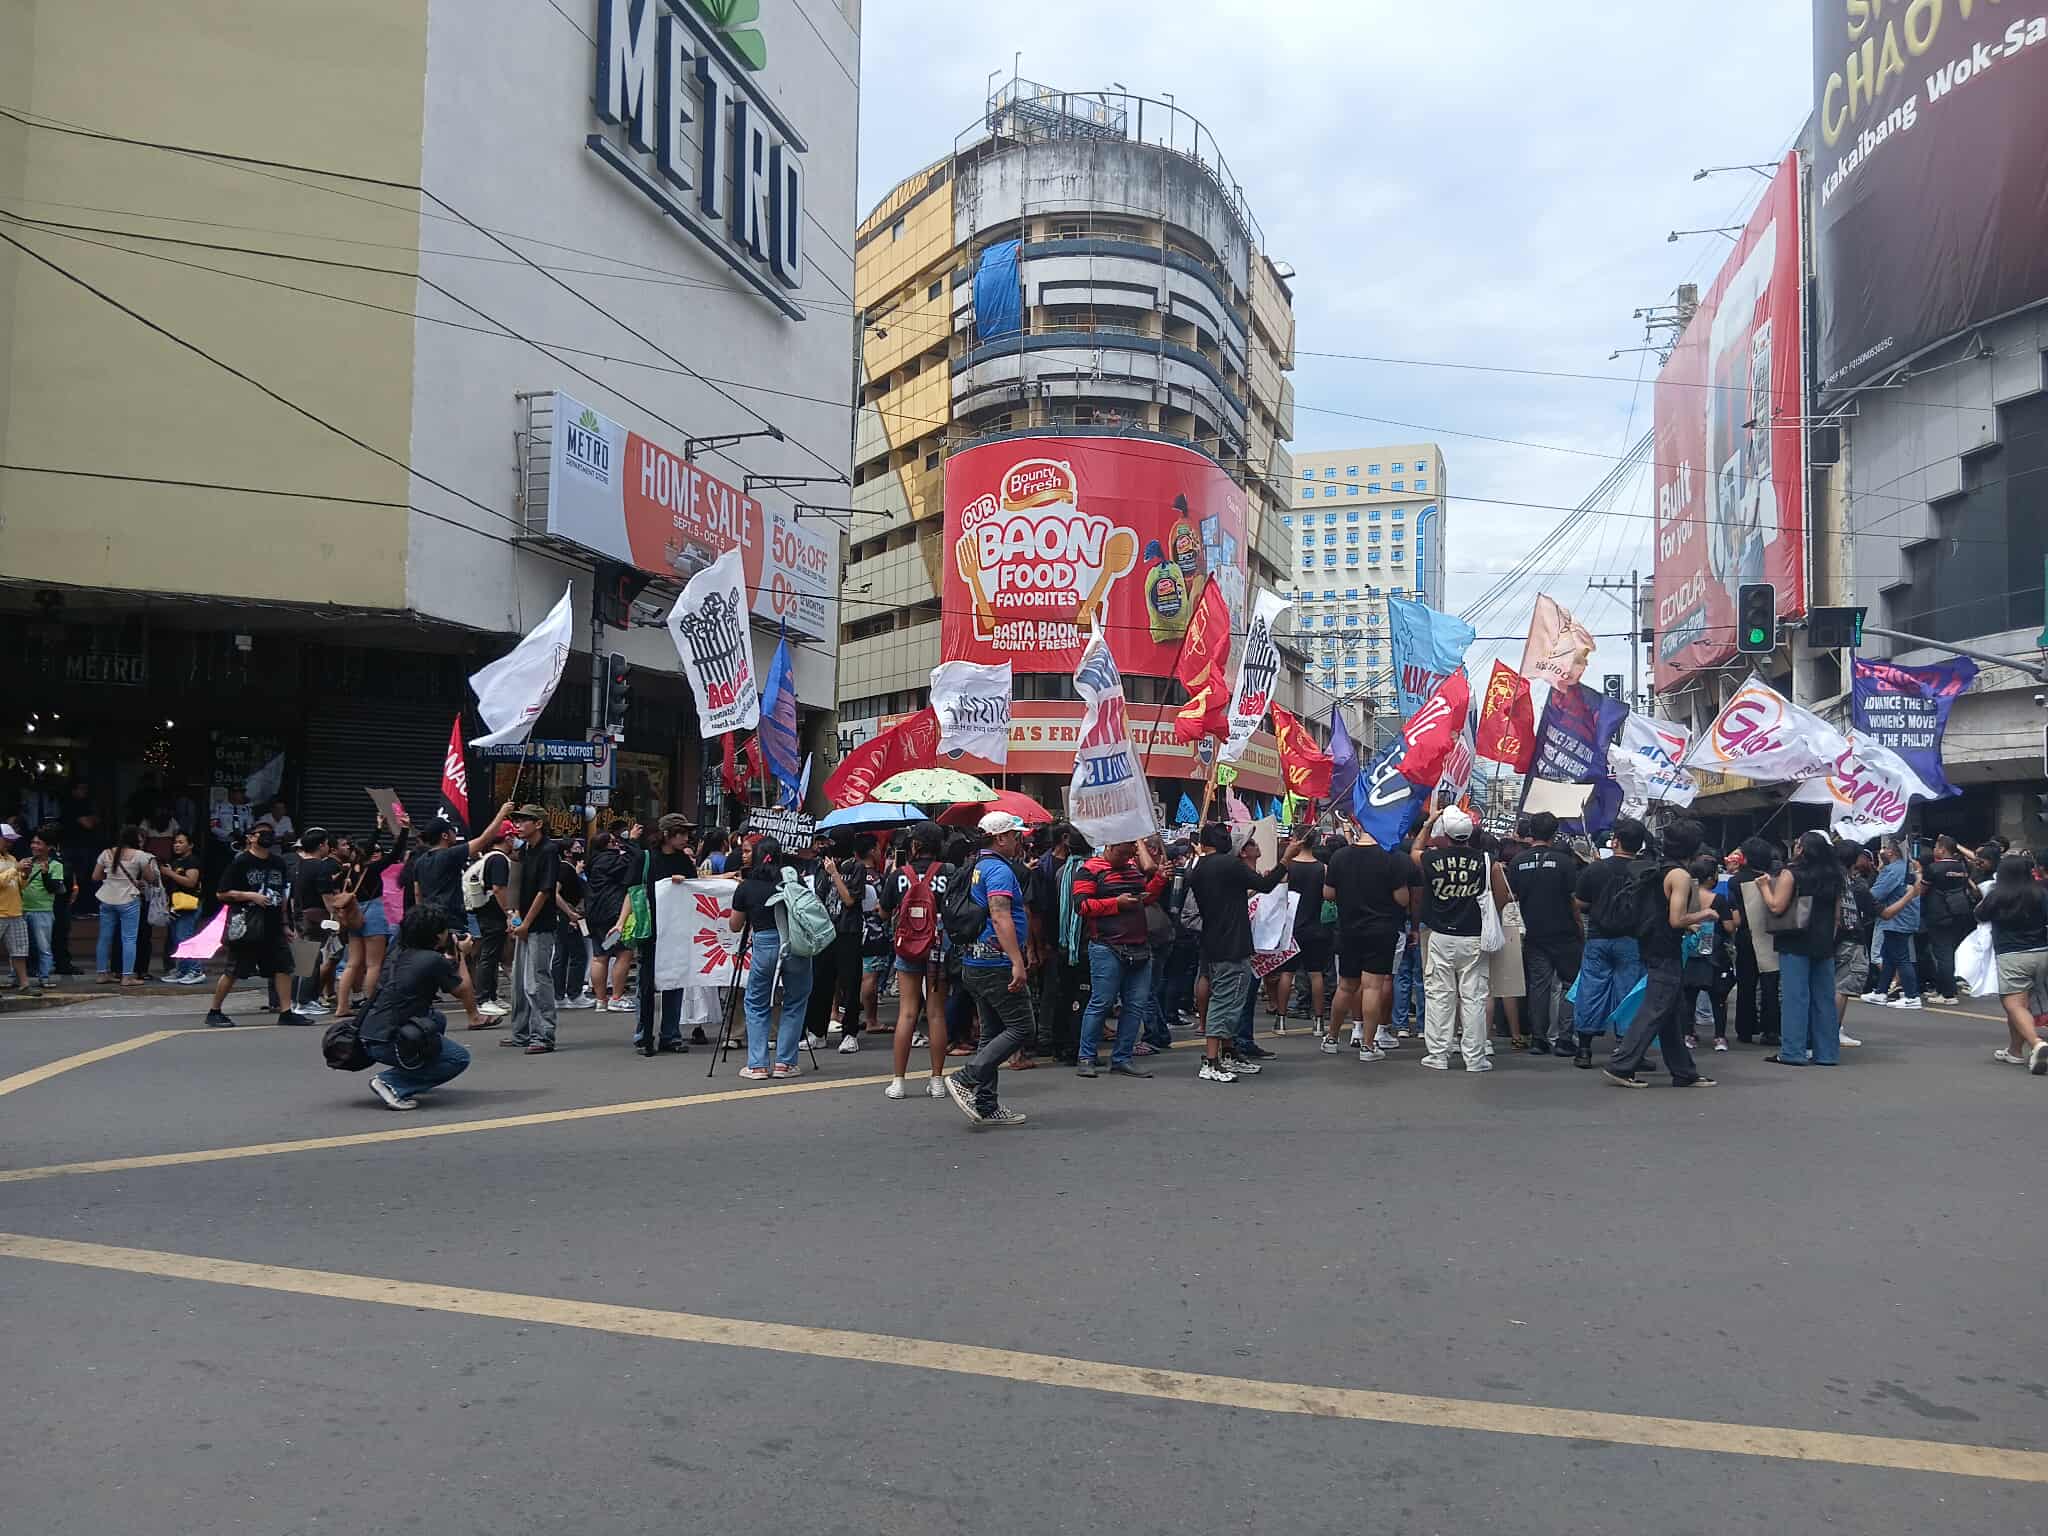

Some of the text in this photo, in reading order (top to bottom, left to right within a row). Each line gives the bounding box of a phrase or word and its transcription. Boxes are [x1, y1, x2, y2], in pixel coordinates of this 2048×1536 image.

[597, 0, 804, 289] METRO
[1822, 94, 1918, 206] Kakaibang
[567, 424, 609, 470] METRO
[641, 442, 752, 549] HOME SALE
[1011, 467, 1055, 493] Bounty
[1023, 475, 1061, 496] Fresh
[1659, 459, 1692, 530] Built
[963, 498, 995, 530] OUR
[673, 515, 693, 534] SEPT.
[694, 525, 699, 537] 5
[704, 530, 719, 545] OCT.
[720, 538, 725, 549] 5
[978, 518, 1107, 569] BAON
[1660, 513, 1693, 563] for you
[772, 526, 828, 574] 50% OFF
[1000, 563, 1074, 590] FOOD
[772, 572, 798, 615] 0%
[996, 592, 1077, 608] FAVORITES
[992, 637, 1081, 651] BOUNTY FRESH!
[1864, 695, 1901, 710] ADVANCE
[1903, 696, 1921, 710] THE
[546, 745, 594, 758] POLICE OUTPOST
[1431, 856, 1483, 872] WHER
[1448, 870, 1469, 882] TO
